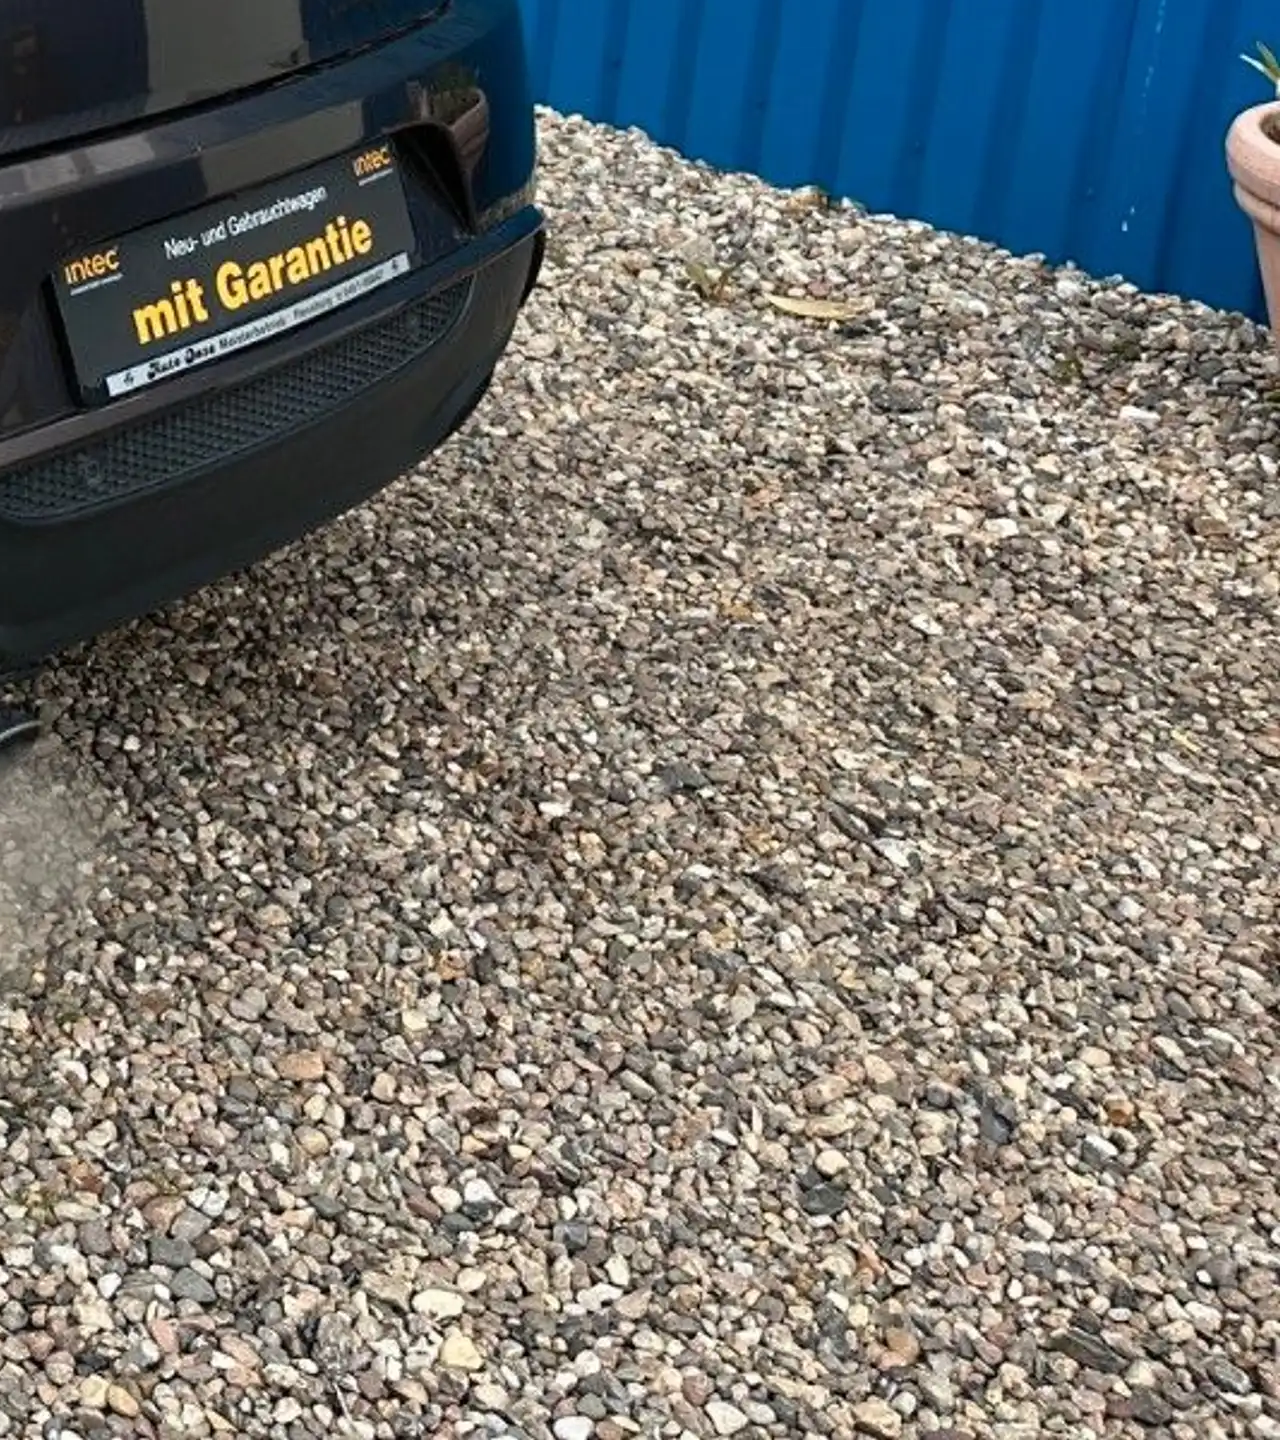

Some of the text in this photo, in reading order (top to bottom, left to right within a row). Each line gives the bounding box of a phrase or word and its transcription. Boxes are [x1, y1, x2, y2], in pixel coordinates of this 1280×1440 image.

[164, 185, 329, 260] Neu- und Gebrauchtwagen
[63, 246, 121, 285] intec
[132, 277, 209, 345] mit
[216, 215, 373, 310] Garantie
